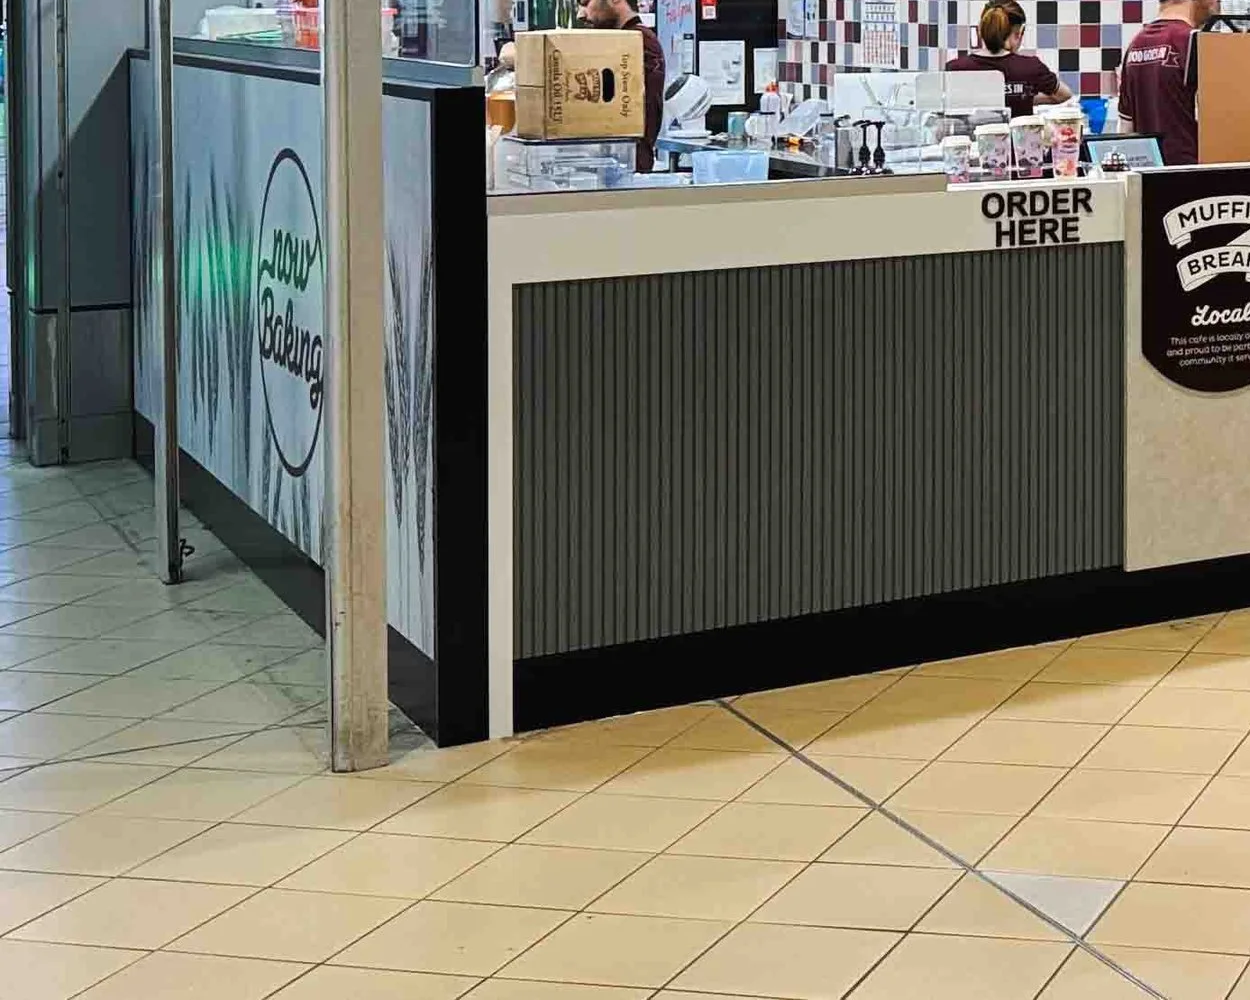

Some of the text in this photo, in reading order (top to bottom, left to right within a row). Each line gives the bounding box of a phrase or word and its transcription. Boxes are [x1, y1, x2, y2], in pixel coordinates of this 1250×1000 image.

[981, 188, 1093, 219] ORDER
[995, 217, 1080, 247] HERE
[261, 287, 324, 410] Baking
[1166, 347, 1183, 357] and
[1185, 346, 1210, 357] proud
[1211, 344, 1220, 353] to
[1222, 343, 1232, 352] be
[1232, 342, 1250, 352] part
[1171, 336, 1187, 346] This
[1209, 335, 1216, 343] is
[1217, 332, 1244, 343] locally
[1179, 356, 1226, 368] community
